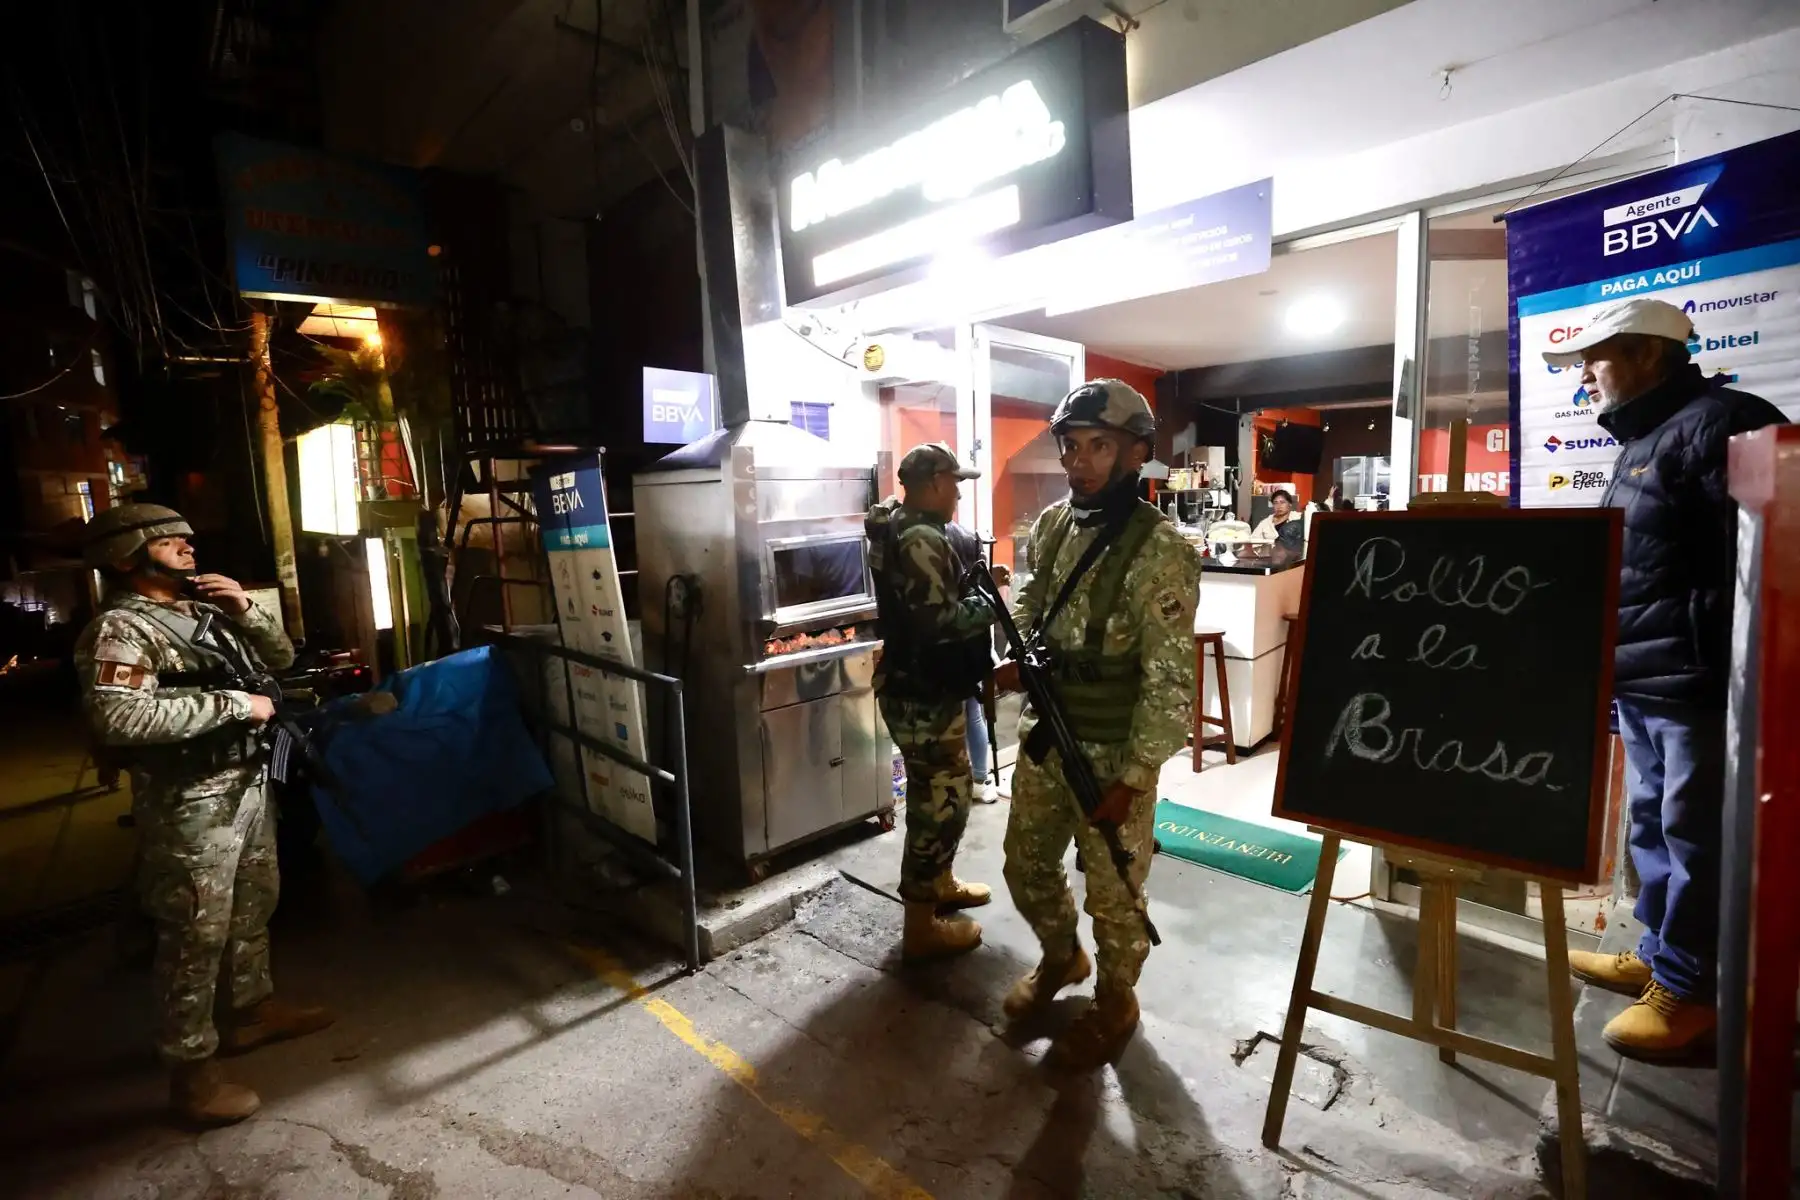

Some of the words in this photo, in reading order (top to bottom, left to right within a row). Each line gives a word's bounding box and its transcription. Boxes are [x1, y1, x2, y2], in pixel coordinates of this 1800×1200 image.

[1626, 196, 1681, 217] Agente
[1602, 205, 1719, 256] BBVA
[1601, 276, 1649, 296] PAGA
[1652, 261, 1702, 286] AQUÍ
[1700, 290, 1778, 312] movistar
[1706, 331, 1759, 351] bitel
[652, 404, 704, 423] BBVA
[1419, 471, 1510, 492] TRNSF
[1573, 470, 1604, 481] Pago
[552, 488, 585, 514] BBVA
[1345, 536, 1557, 615] Pollo
[1350, 633, 1386, 660] a
[1407, 624, 1488, 670] la
[1324, 692, 1571, 791] Brasa
[1158, 821, 1293, 865] BIENVENIDO
